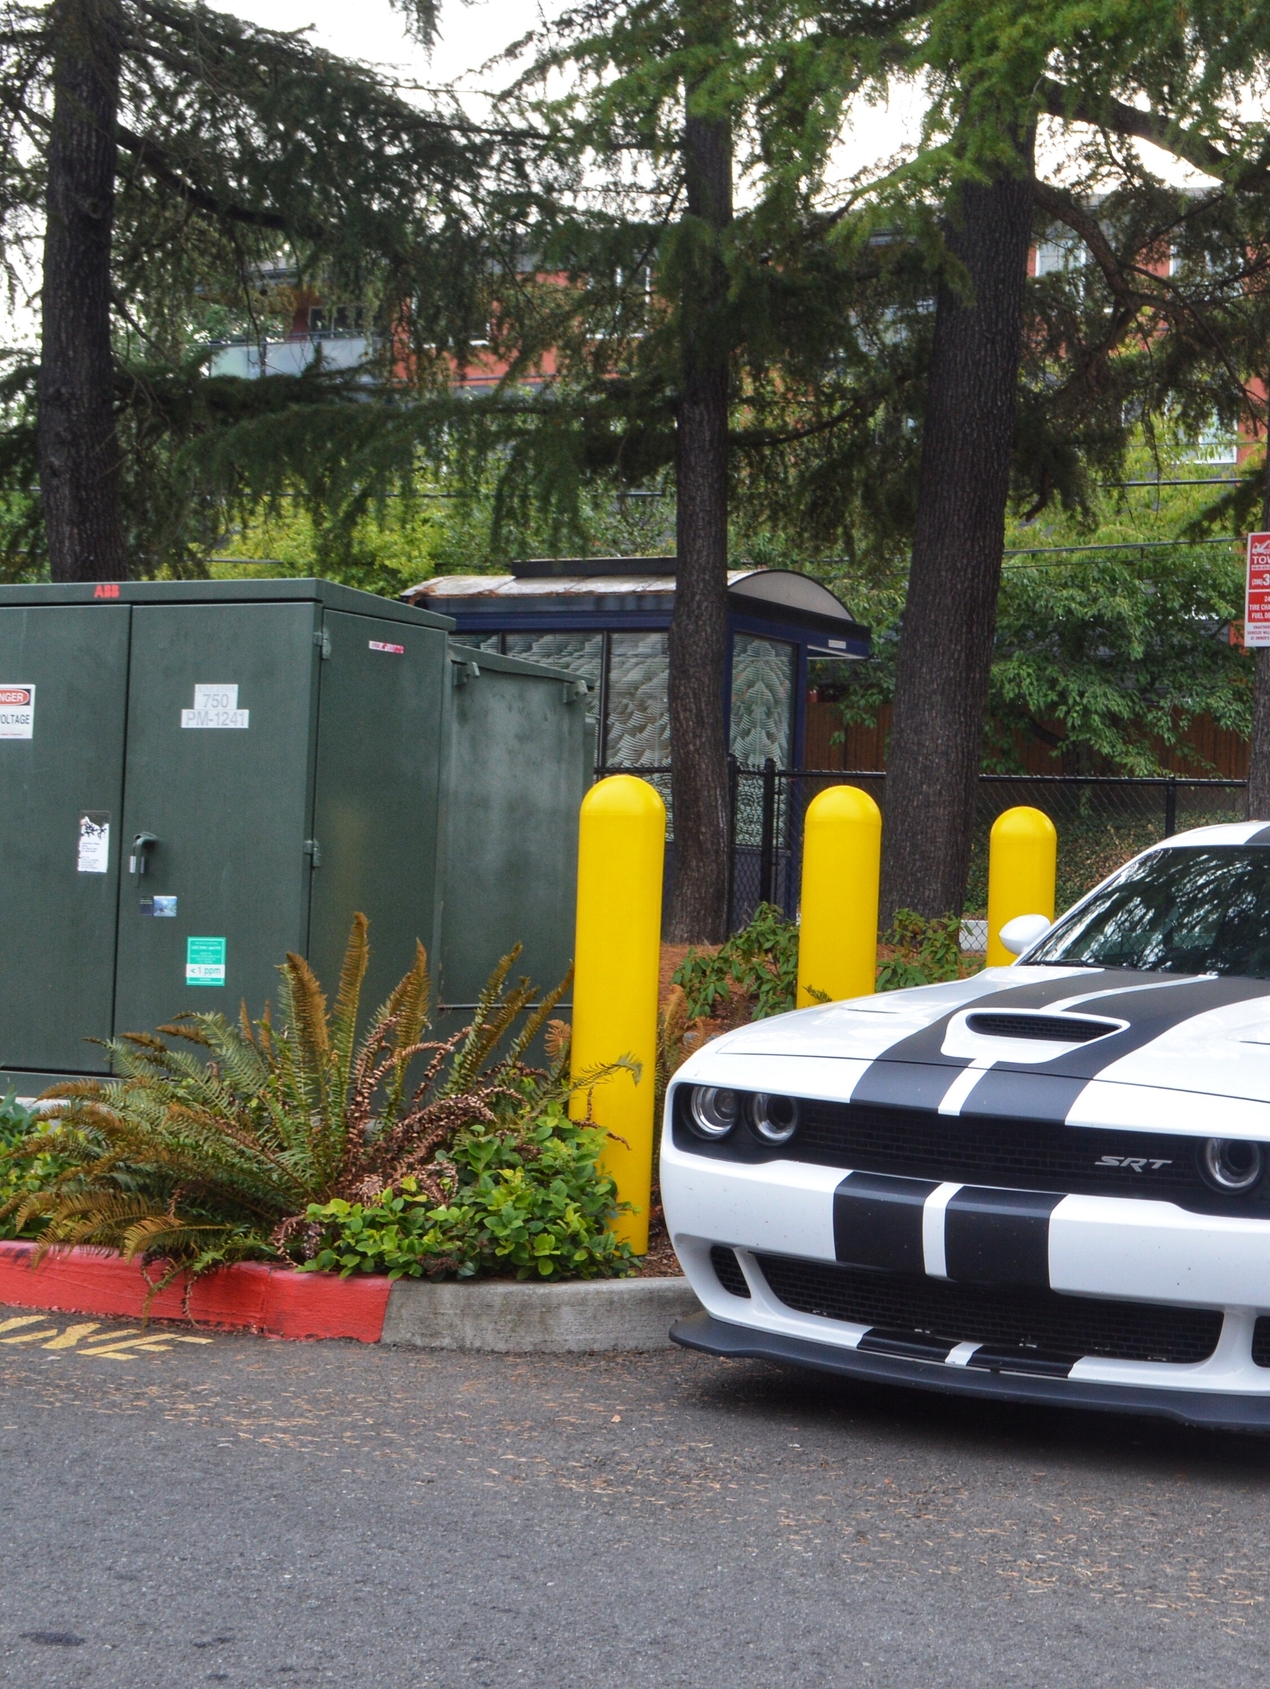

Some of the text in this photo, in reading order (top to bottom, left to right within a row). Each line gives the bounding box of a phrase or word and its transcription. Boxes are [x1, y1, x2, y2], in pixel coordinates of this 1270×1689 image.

[94, 584, 120, 598] ABB
[203, 694, 229, 708] 750
[0, 714, 30, 724] OLTAGE
[186, 711, 244, 726] PM-1241
[1094, 1156, 1172, 1172] SRT
